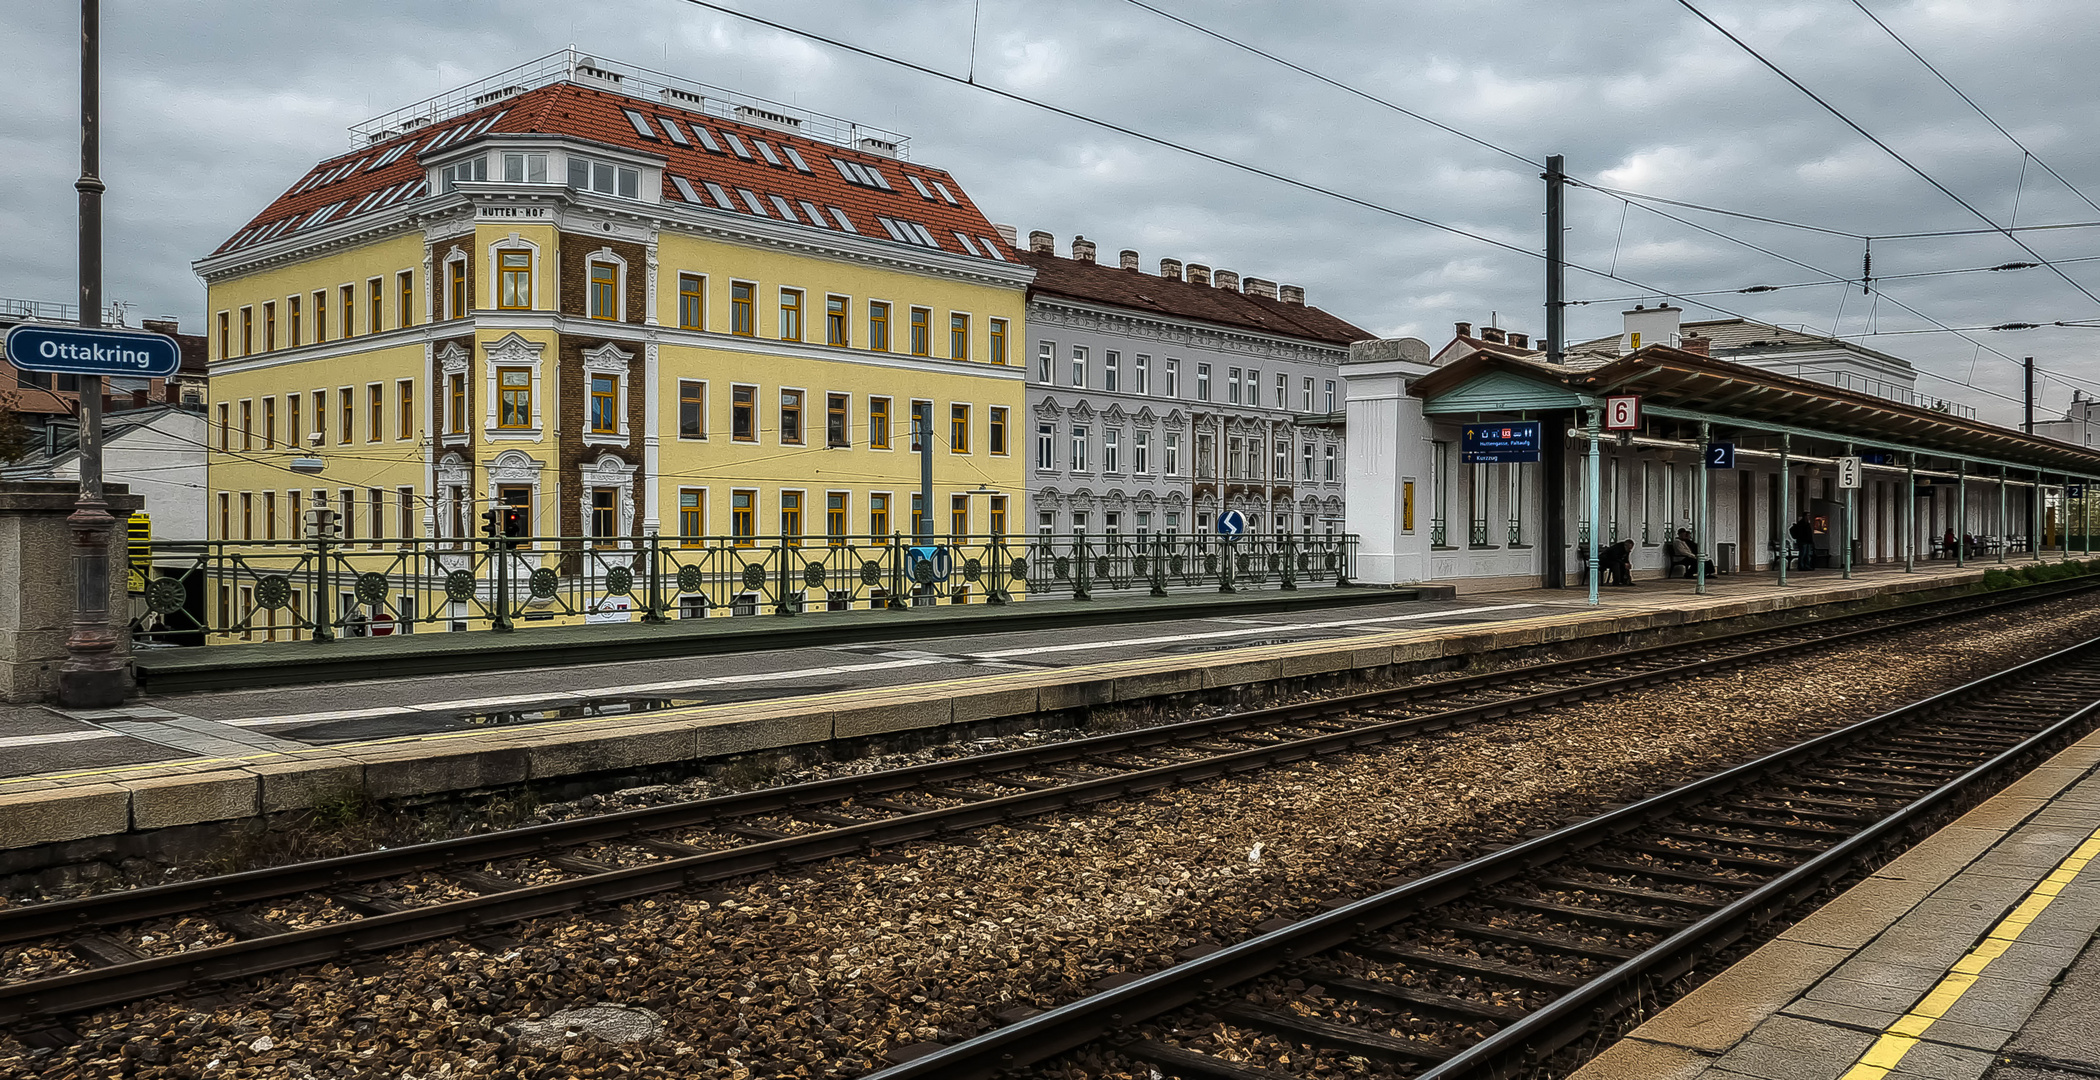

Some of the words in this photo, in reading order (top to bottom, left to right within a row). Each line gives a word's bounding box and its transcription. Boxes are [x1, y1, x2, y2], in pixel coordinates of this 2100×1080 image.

[40, 341, 150, 368] Ottakring
[1616, 401, 1627, 423] 6
[1502, 429, 1511, 437] U3
[1714, 448, 1725, 464] 2
[1886, 454, 1893, 464] 2
[1845, 459, 1853, 471] 2
[1845, 473, 1853, 485] 5
[2072, 487, 2079, 496] 2
